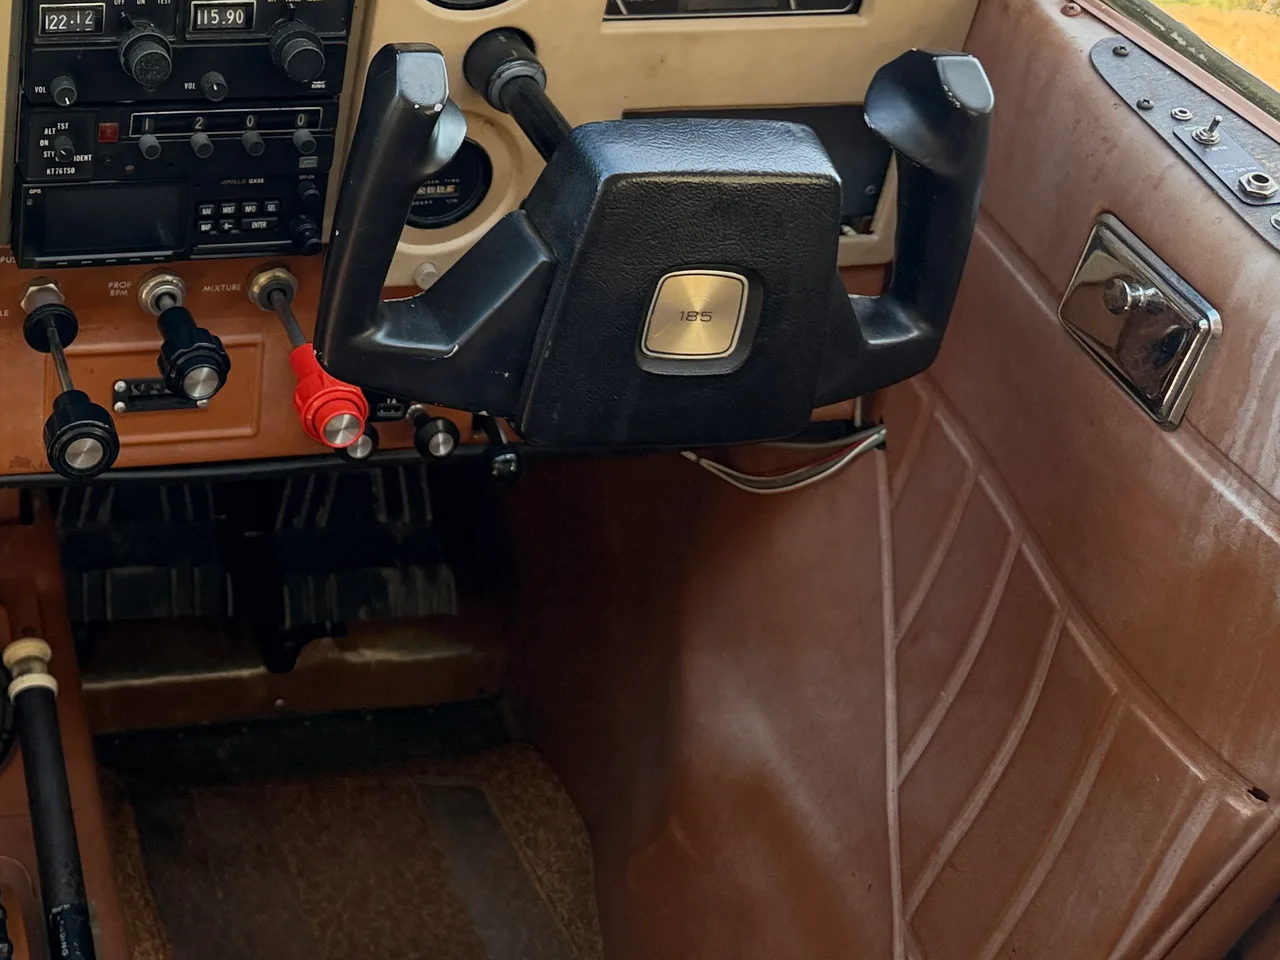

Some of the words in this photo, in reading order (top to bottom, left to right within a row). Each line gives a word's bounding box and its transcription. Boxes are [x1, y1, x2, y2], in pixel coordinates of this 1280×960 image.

[197, 9, 244, 25] 115.90
[74, 154, 92, 162] IDENT
[222, 206, 235, 214] NRST
[245, 205, 256, 213] INFO
[201, 223, 212, 231] MAP
[251, 221, 267, 229] ENTER
[108, 281, 132, 289] PROP
[203, 283, 242, 292] MIXTURE
[109, 289, 129, 297] RPM
[680, 311, 712, 322] 185
